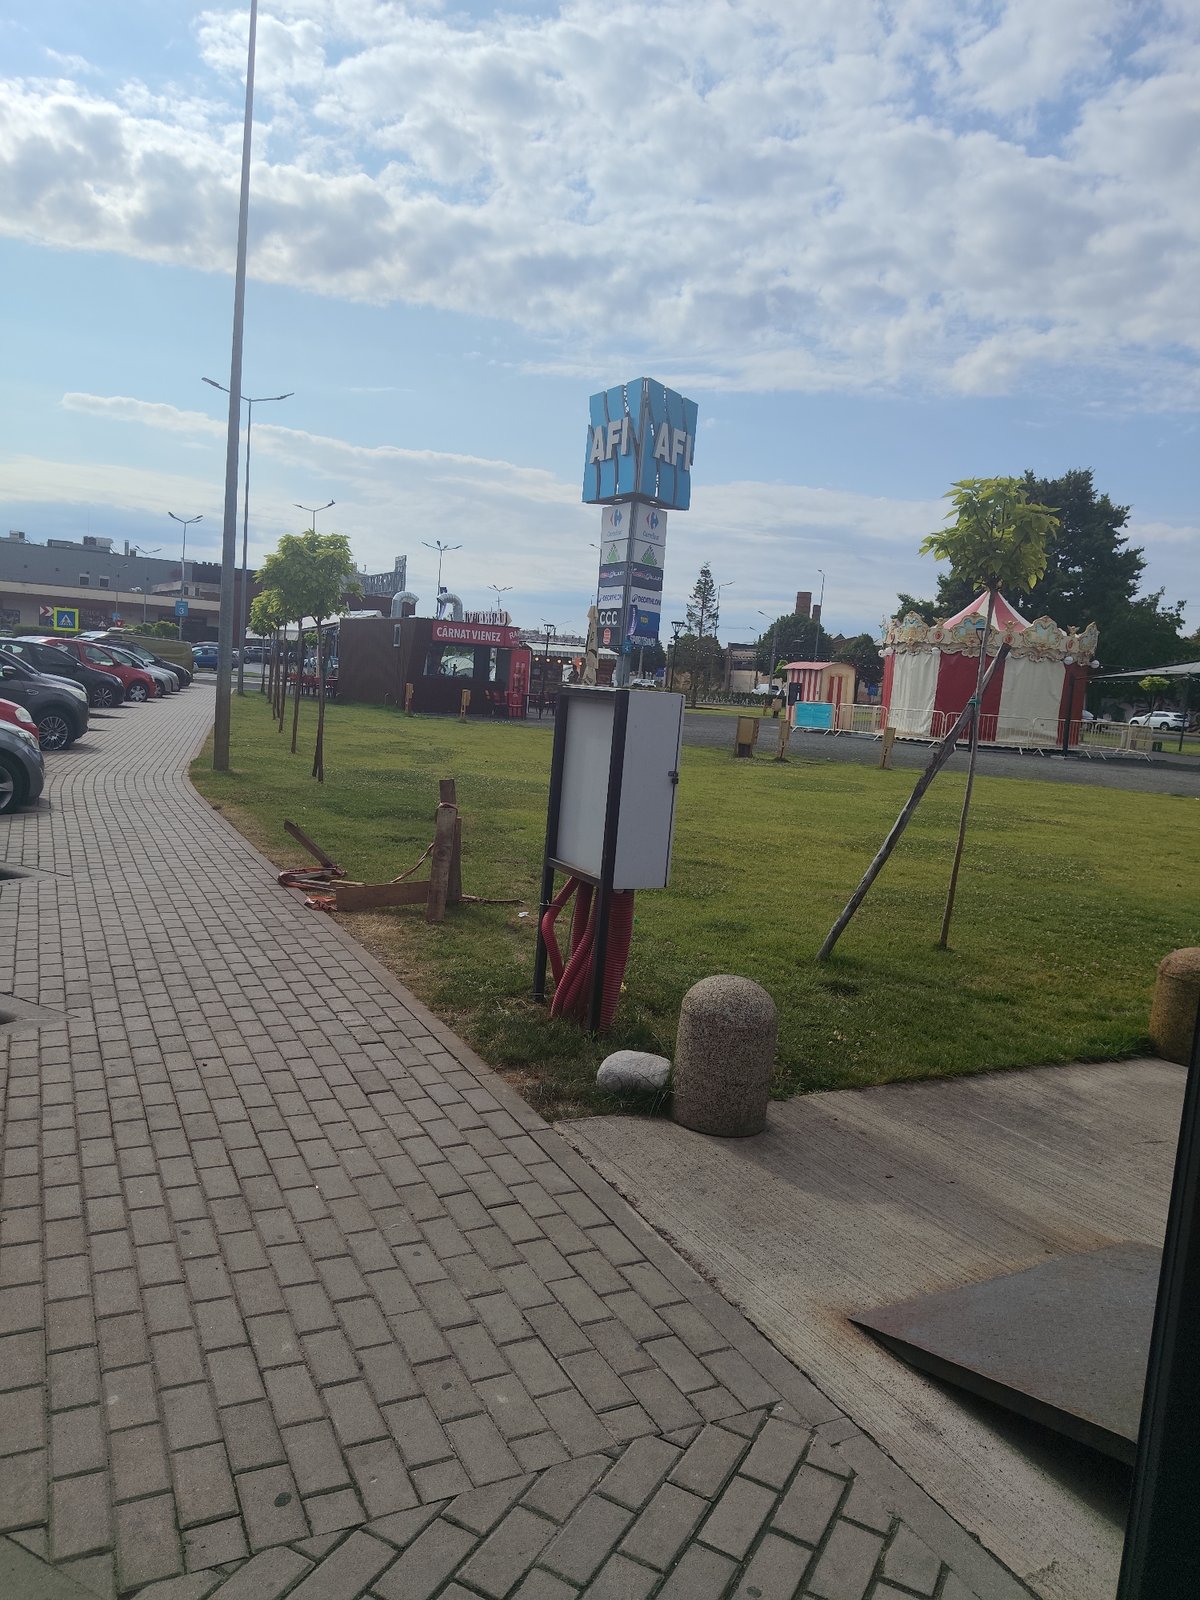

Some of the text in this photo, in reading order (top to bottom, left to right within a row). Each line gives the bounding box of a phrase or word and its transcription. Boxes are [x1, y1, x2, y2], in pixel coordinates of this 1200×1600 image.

[590, 416, 629, 464] AFI
[654, 422, 692, 471] AFI
[638, 596, 661, 606] DECATHLON
[178, 607, 184, 615] 3
[599, 611, 618, 626] CCC
[436, 625, 501, 642] CÂRNAT VIENEZ
